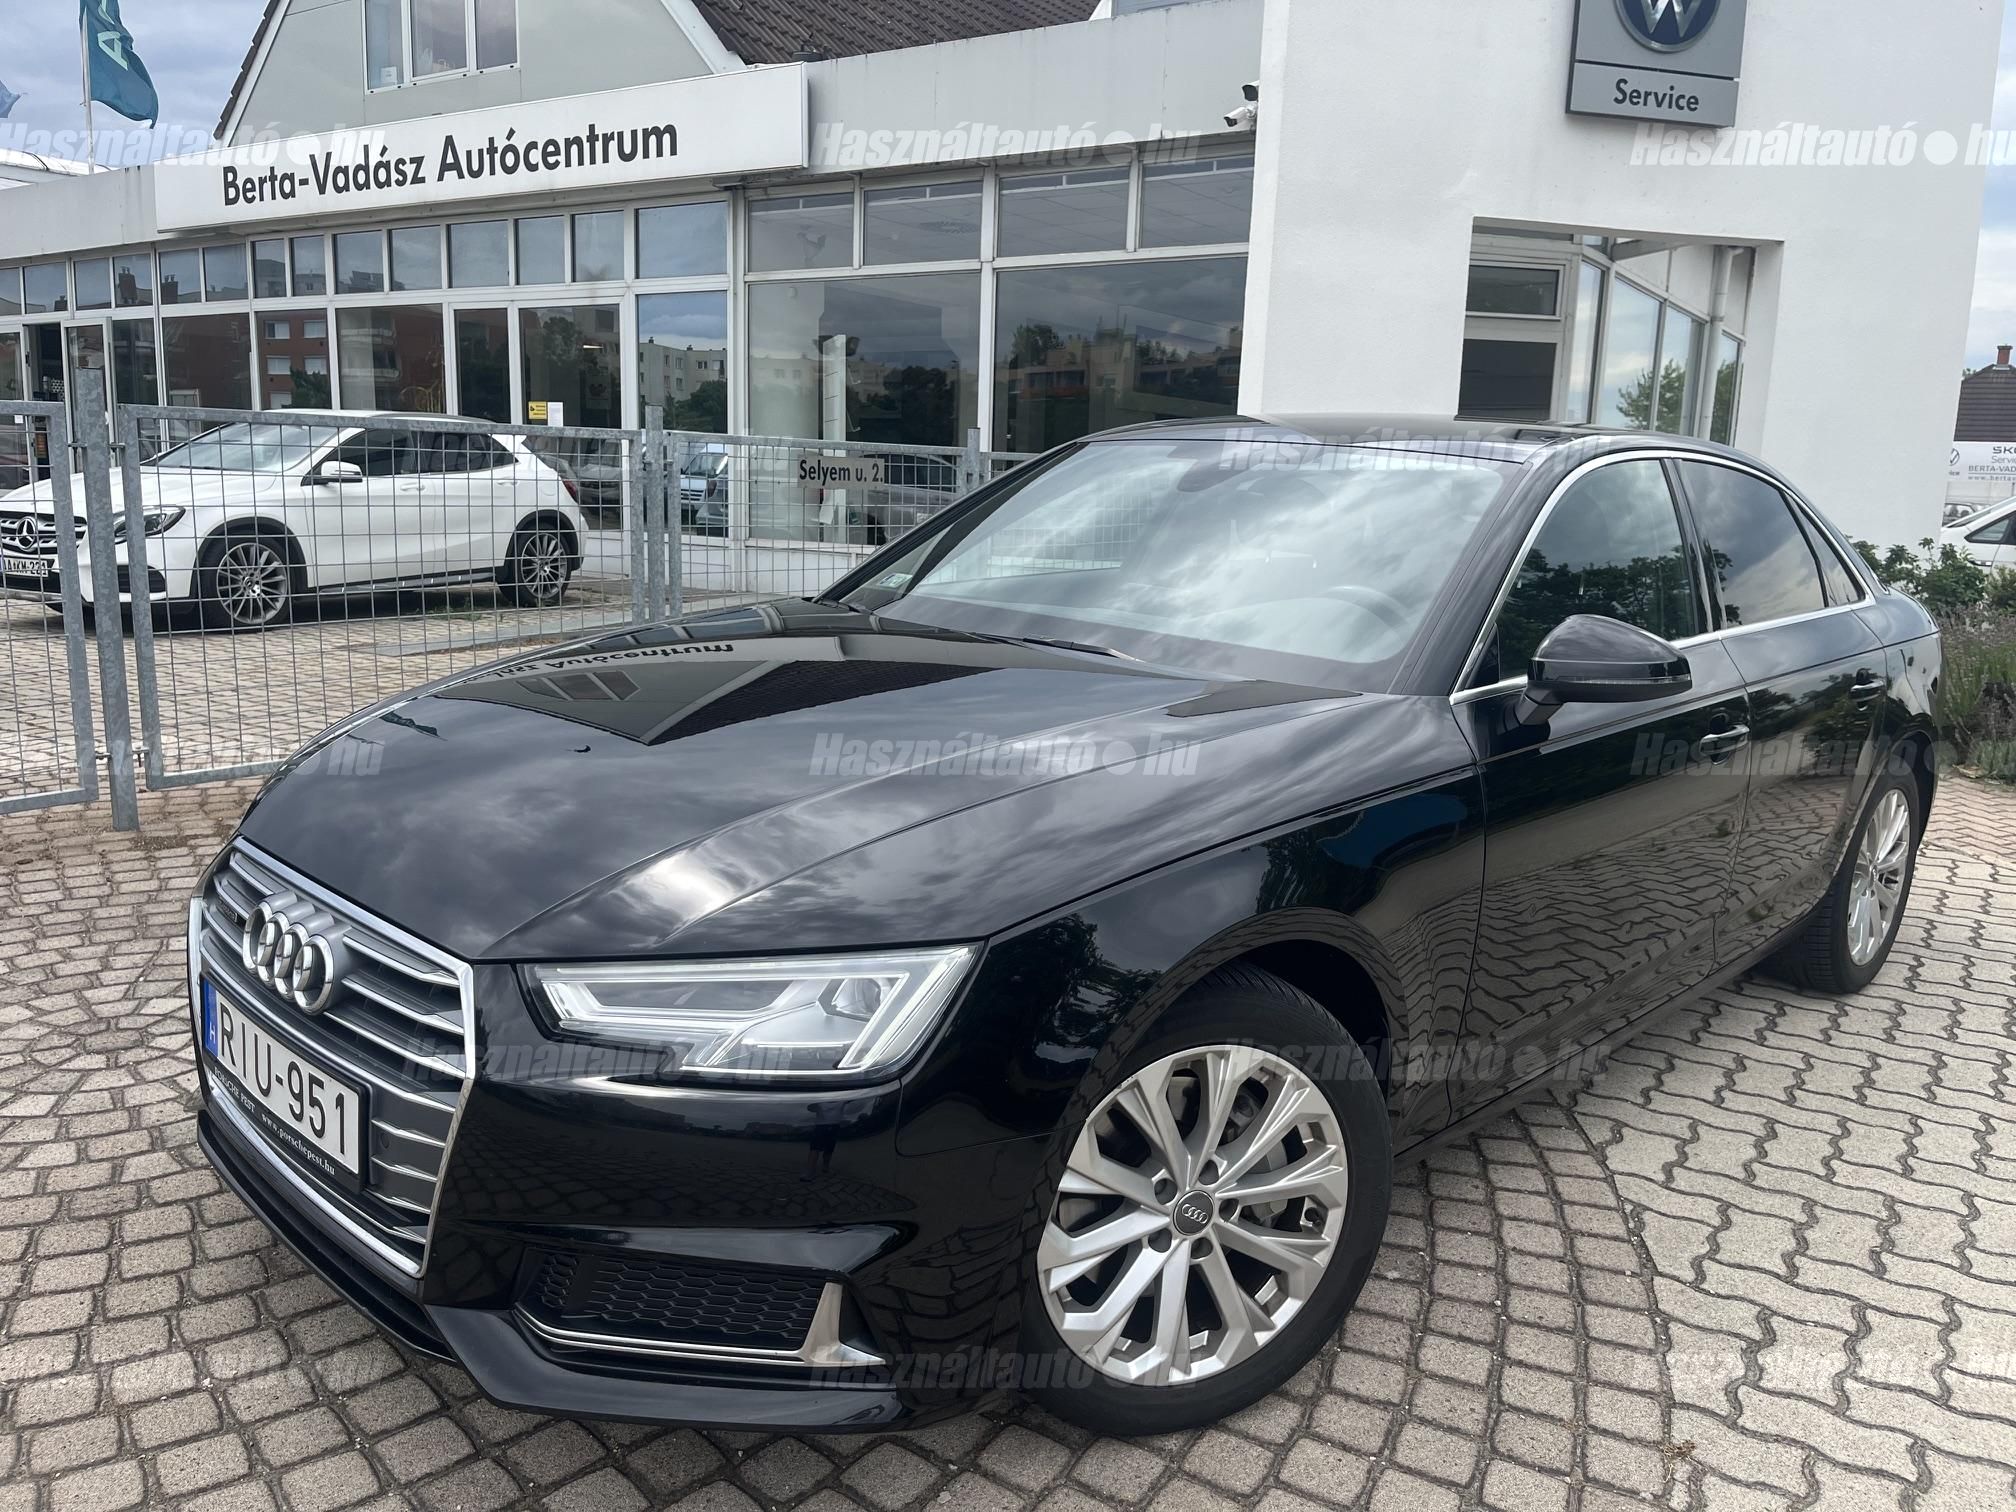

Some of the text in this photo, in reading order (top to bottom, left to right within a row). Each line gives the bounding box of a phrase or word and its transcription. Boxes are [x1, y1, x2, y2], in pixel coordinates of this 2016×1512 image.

[1613, 78, 1699, 112] Service
[222, 123, 678, 206] Berta-Vadász Autócentrum
[1992, 446, 2016, 454] SK
[799, 459, 884, 486] Selyem u. 2.
[209, 1021, 216, 1044] H
[220, 1002, 346, 1156] RIU-951
[261, 1113, 336, 1175] www.porschepest.hu
